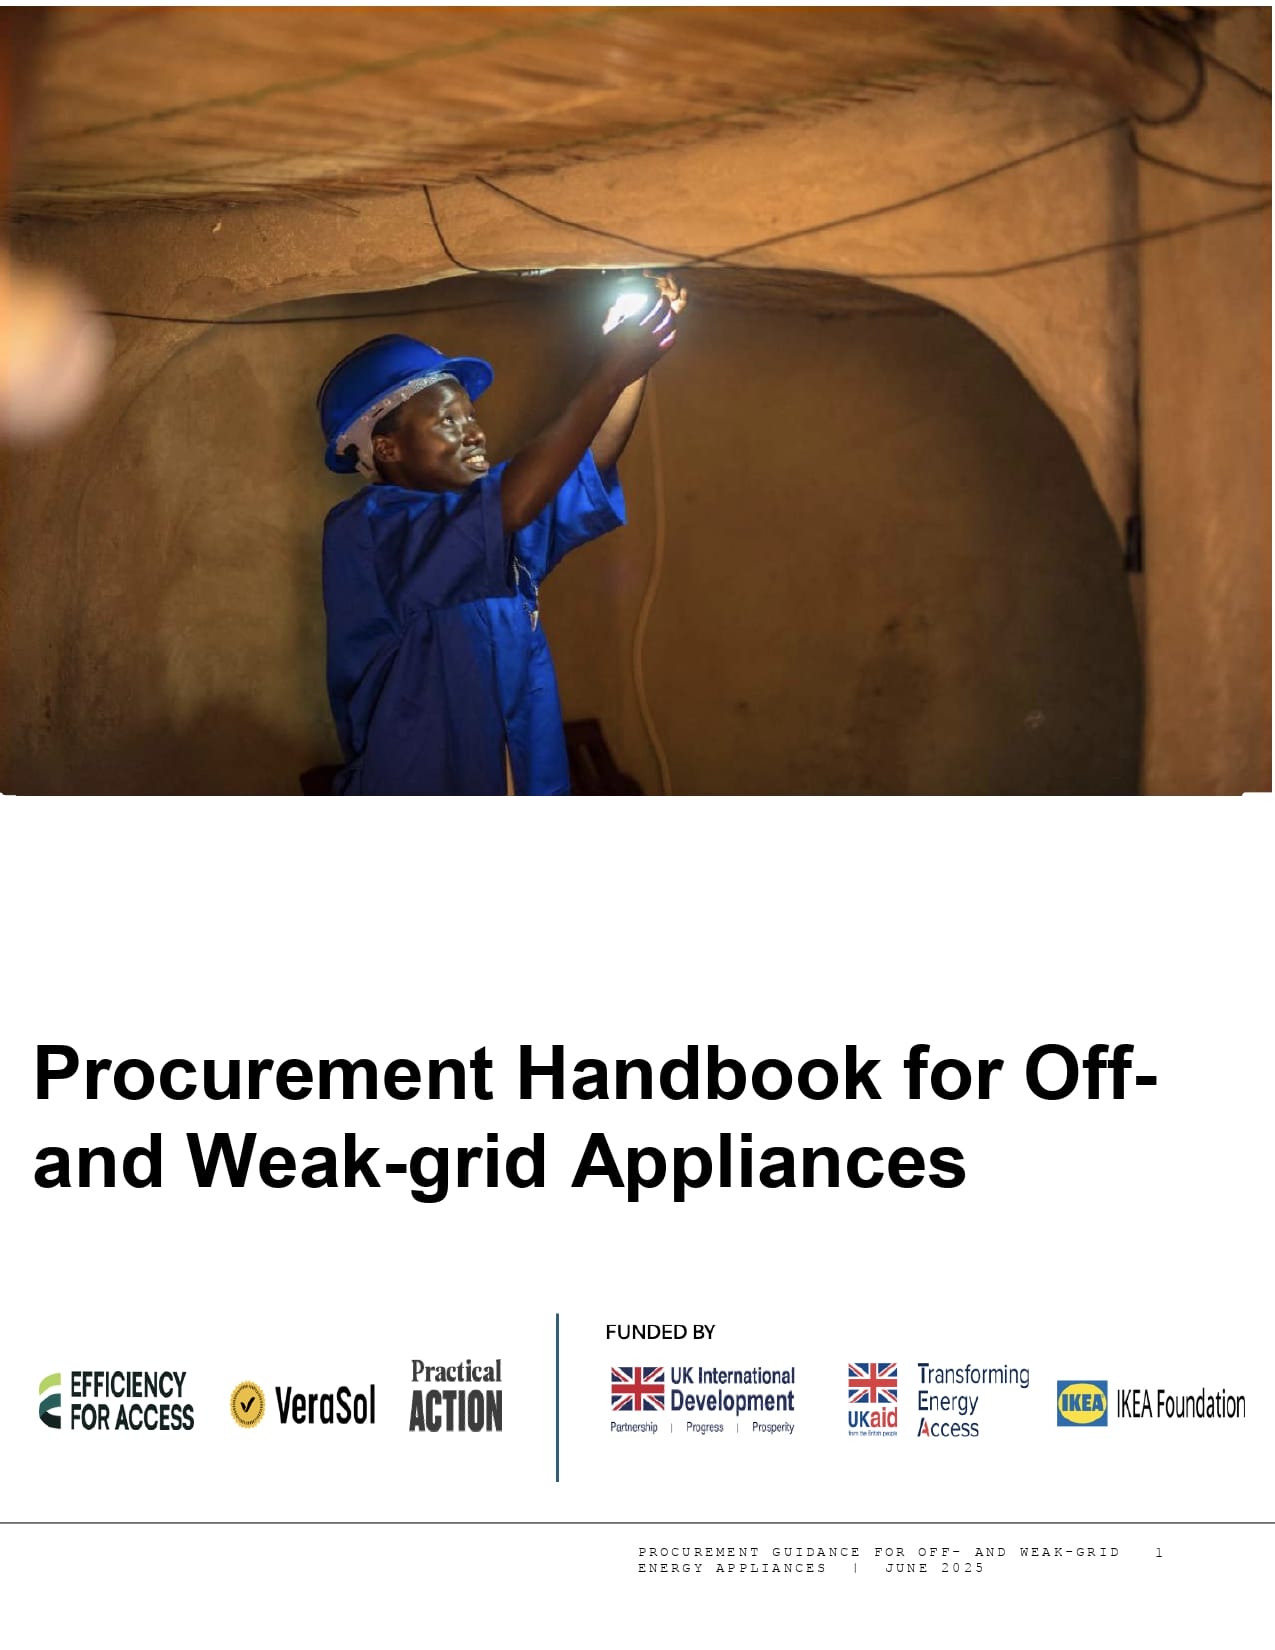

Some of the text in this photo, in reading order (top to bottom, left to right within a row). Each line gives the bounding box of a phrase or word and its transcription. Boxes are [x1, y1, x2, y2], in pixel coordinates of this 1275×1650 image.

[36, 1043, 1158, 1101] Procurement Handbook for Off-
[33, 1132, 966, 1204] and Weak-grid Appliances
[605, 1324, 716, 1340] FUNDED BY
[411, 1358, 502, 1383] Practical
[670, 1366, 795, 1385] UK International
[917, 1362, 1030, 1389] Transforming
[70, 1370, 187, 1399] EFFICIENCY
[274, 1383, 376, 1425] VeraSol
[408, 1389, 503, 1433] ACTION
[670, 1388, 796, 1417] Development
[917, 1389, 979, 1416] Energy
[1062, 1393, 1104, 1412] IKEA
[1117, 1386, 1246, 1419] IKEA Foundation
[70, 1402, 195, 1431] FOR ACCESS
[610, 1421, 658, 1435] Partnership
[686, 1421, 724, 1435] Progress
[752, 1421, 795, 1435] Prosperity
[847, 1406, 898, 1428] UKaid
[916, 1416, 980, 1438] Access
[638, 1547, 1120, 1557] PROCUREMENT GUIDANCE FOR OFF- AND WEAK-GRID
[1155, 1547, 1163, 1558] 1
[637, 1563, 703, 1573] ENERGY
[715, 1563, 826, 1573] APPLIANCES
[885, 1563, 928, 1573] JUNE
[941, 1562, 984, 1573] 2025
